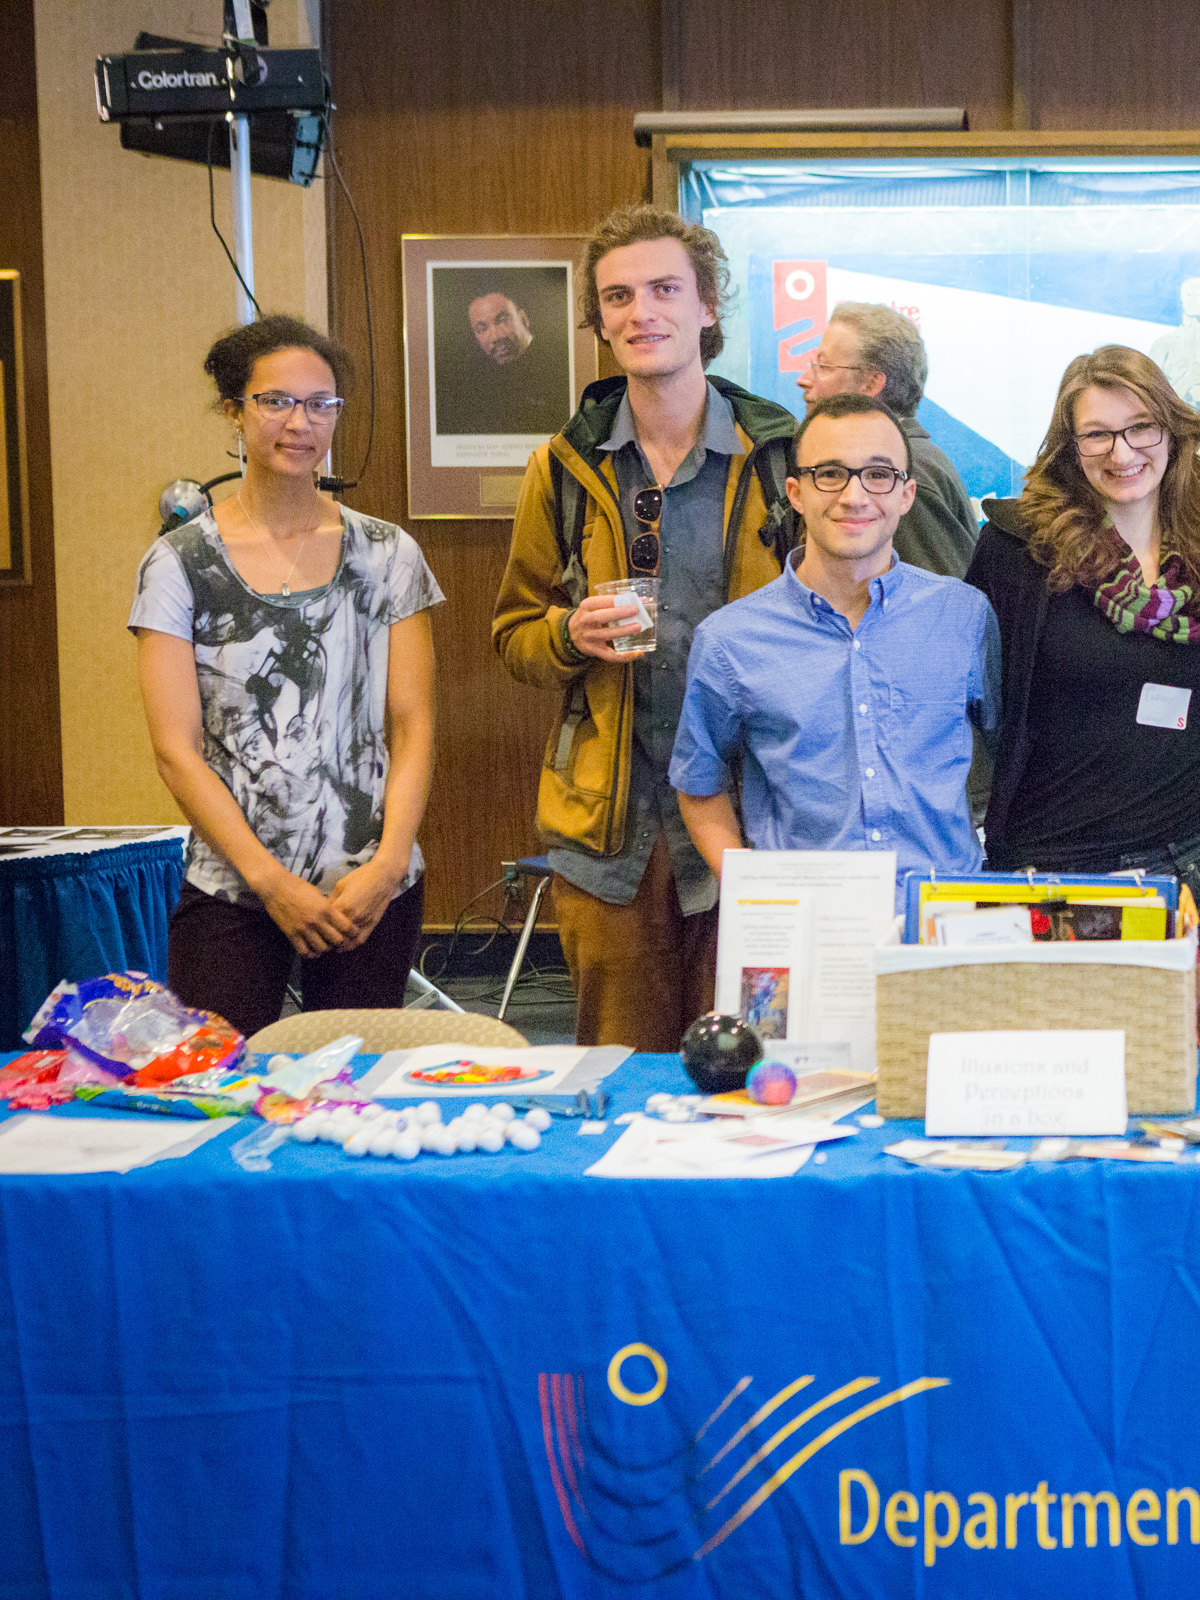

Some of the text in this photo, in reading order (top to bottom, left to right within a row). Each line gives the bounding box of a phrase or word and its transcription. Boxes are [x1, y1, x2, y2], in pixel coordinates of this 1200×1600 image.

[138, 70, 219, 90] Colortran
[960, 1057, 1089, 1075] Illusions and
[964, 1082, 1086, 1102] Perceptions
[984, 1109, 1004, 1127] in
[1027, 1109, 1065, 1127] box
